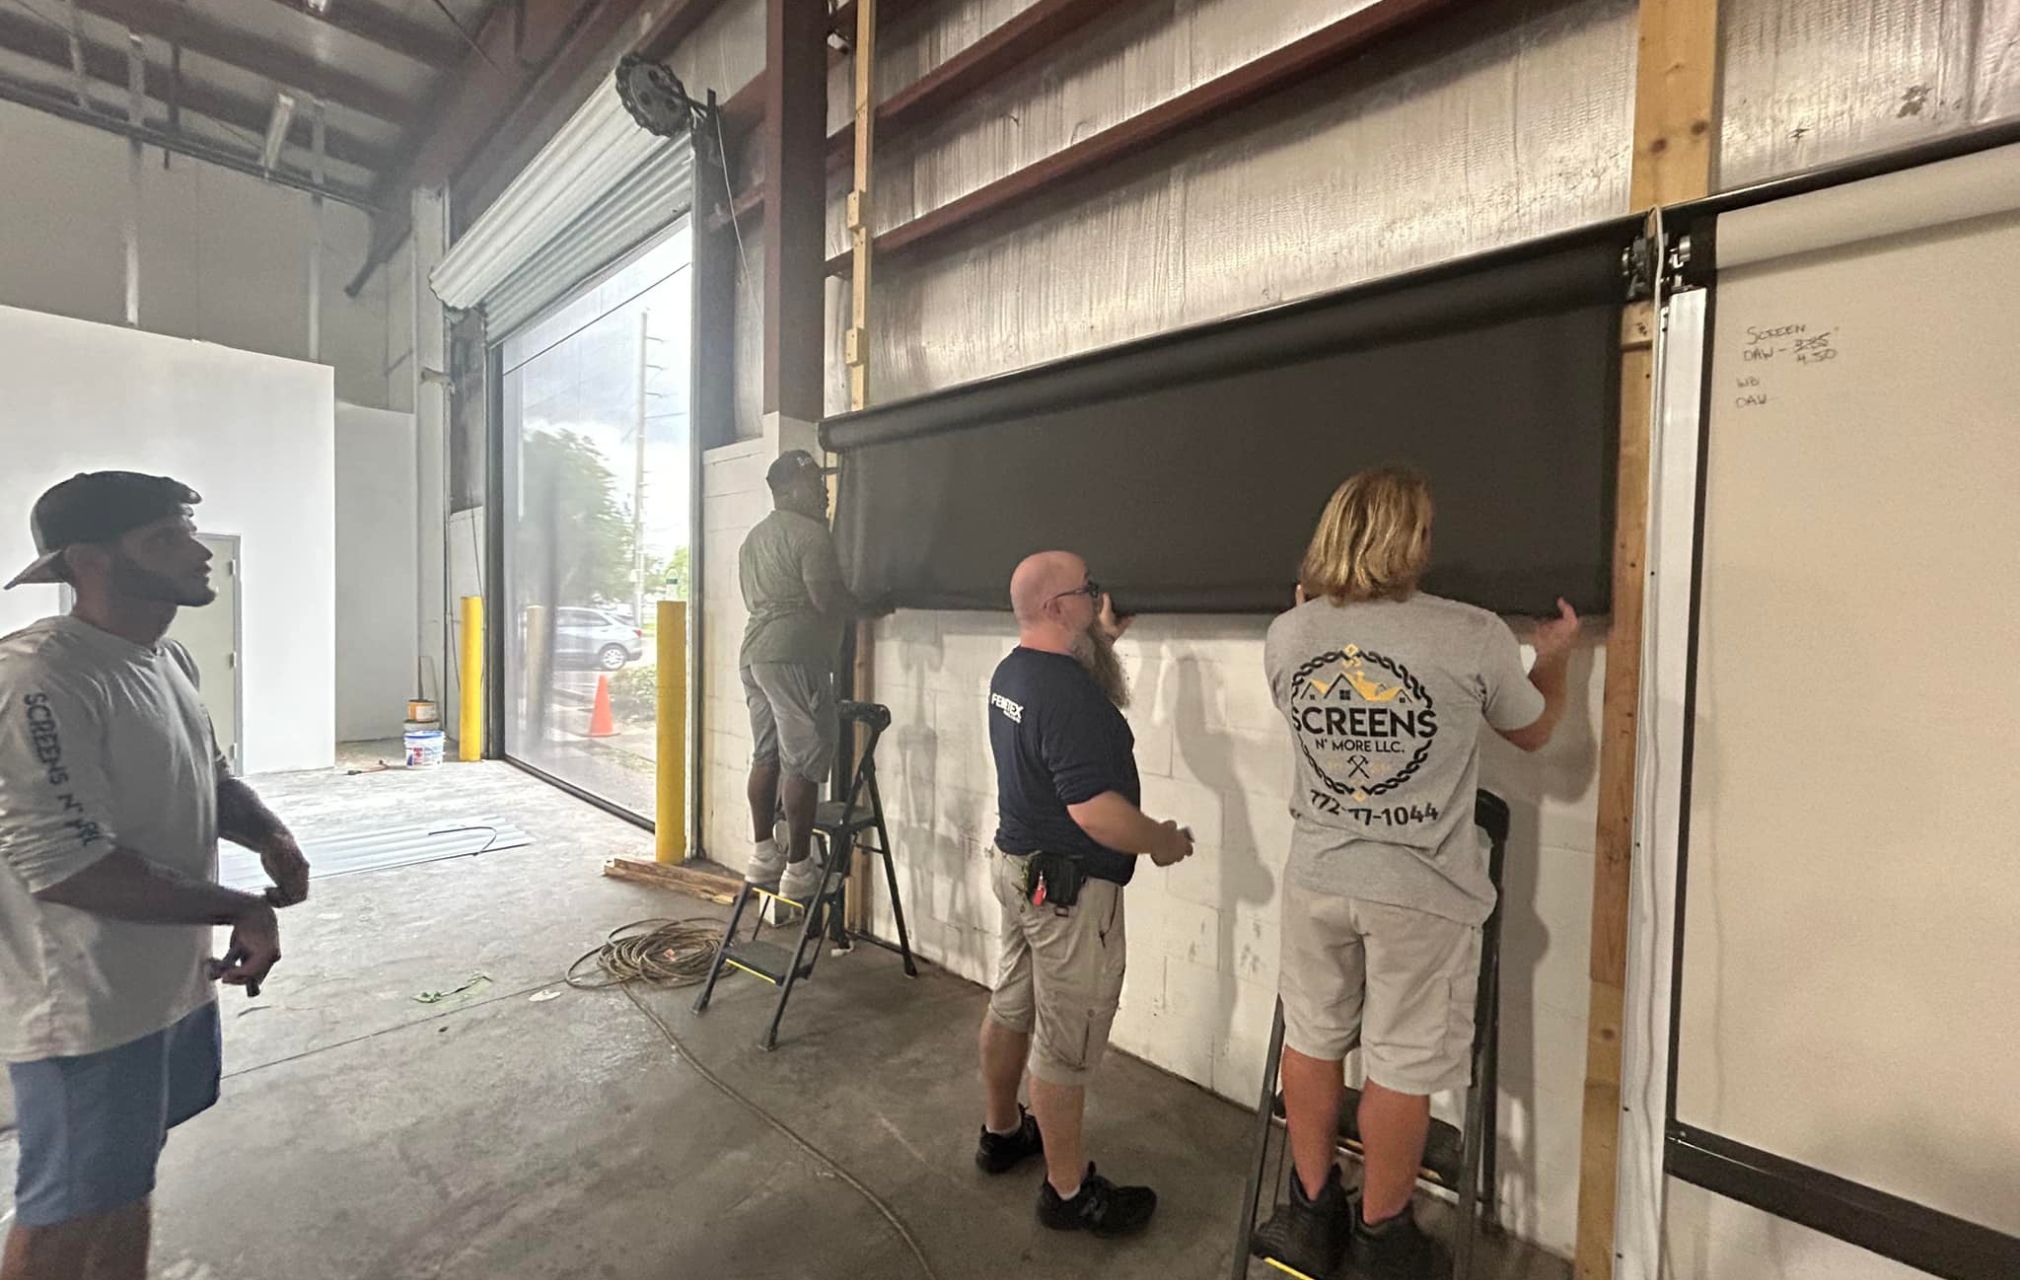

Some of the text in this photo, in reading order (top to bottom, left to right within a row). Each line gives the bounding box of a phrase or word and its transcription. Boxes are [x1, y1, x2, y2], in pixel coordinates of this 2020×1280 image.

[1292, 706, 1438, 738] SCREENS
[24, 692, 69, 785] SCREENS
[1332, 739, 1371, 751] MORE
[1375, 740, 1405, 753] LLC.
